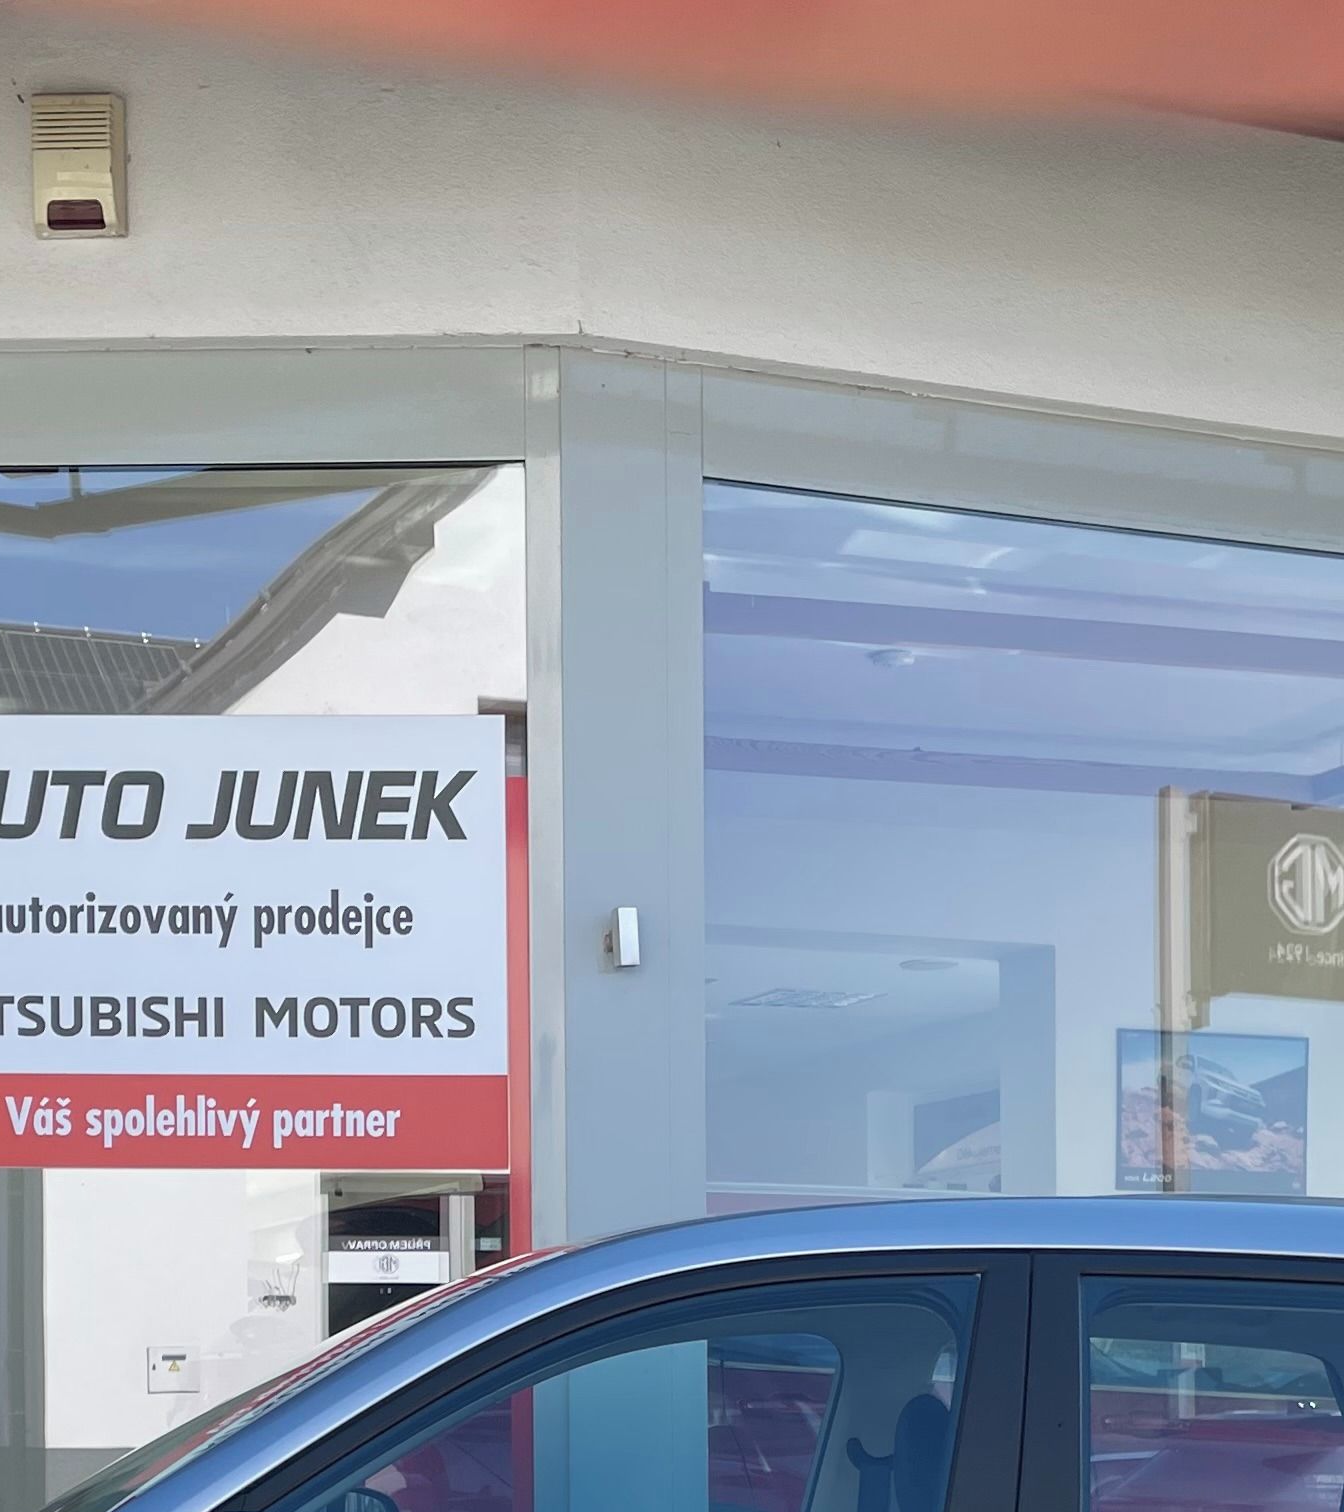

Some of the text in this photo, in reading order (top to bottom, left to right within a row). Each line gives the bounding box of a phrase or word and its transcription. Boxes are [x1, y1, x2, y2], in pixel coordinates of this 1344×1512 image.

[185, 769, 478, 841] JUNEK
[253, 888, 414, 949] prodejce
[255, 996, 477, 1039] MOTORS
[5, 1094, 402, 1149] Váš spolehlivý partner
